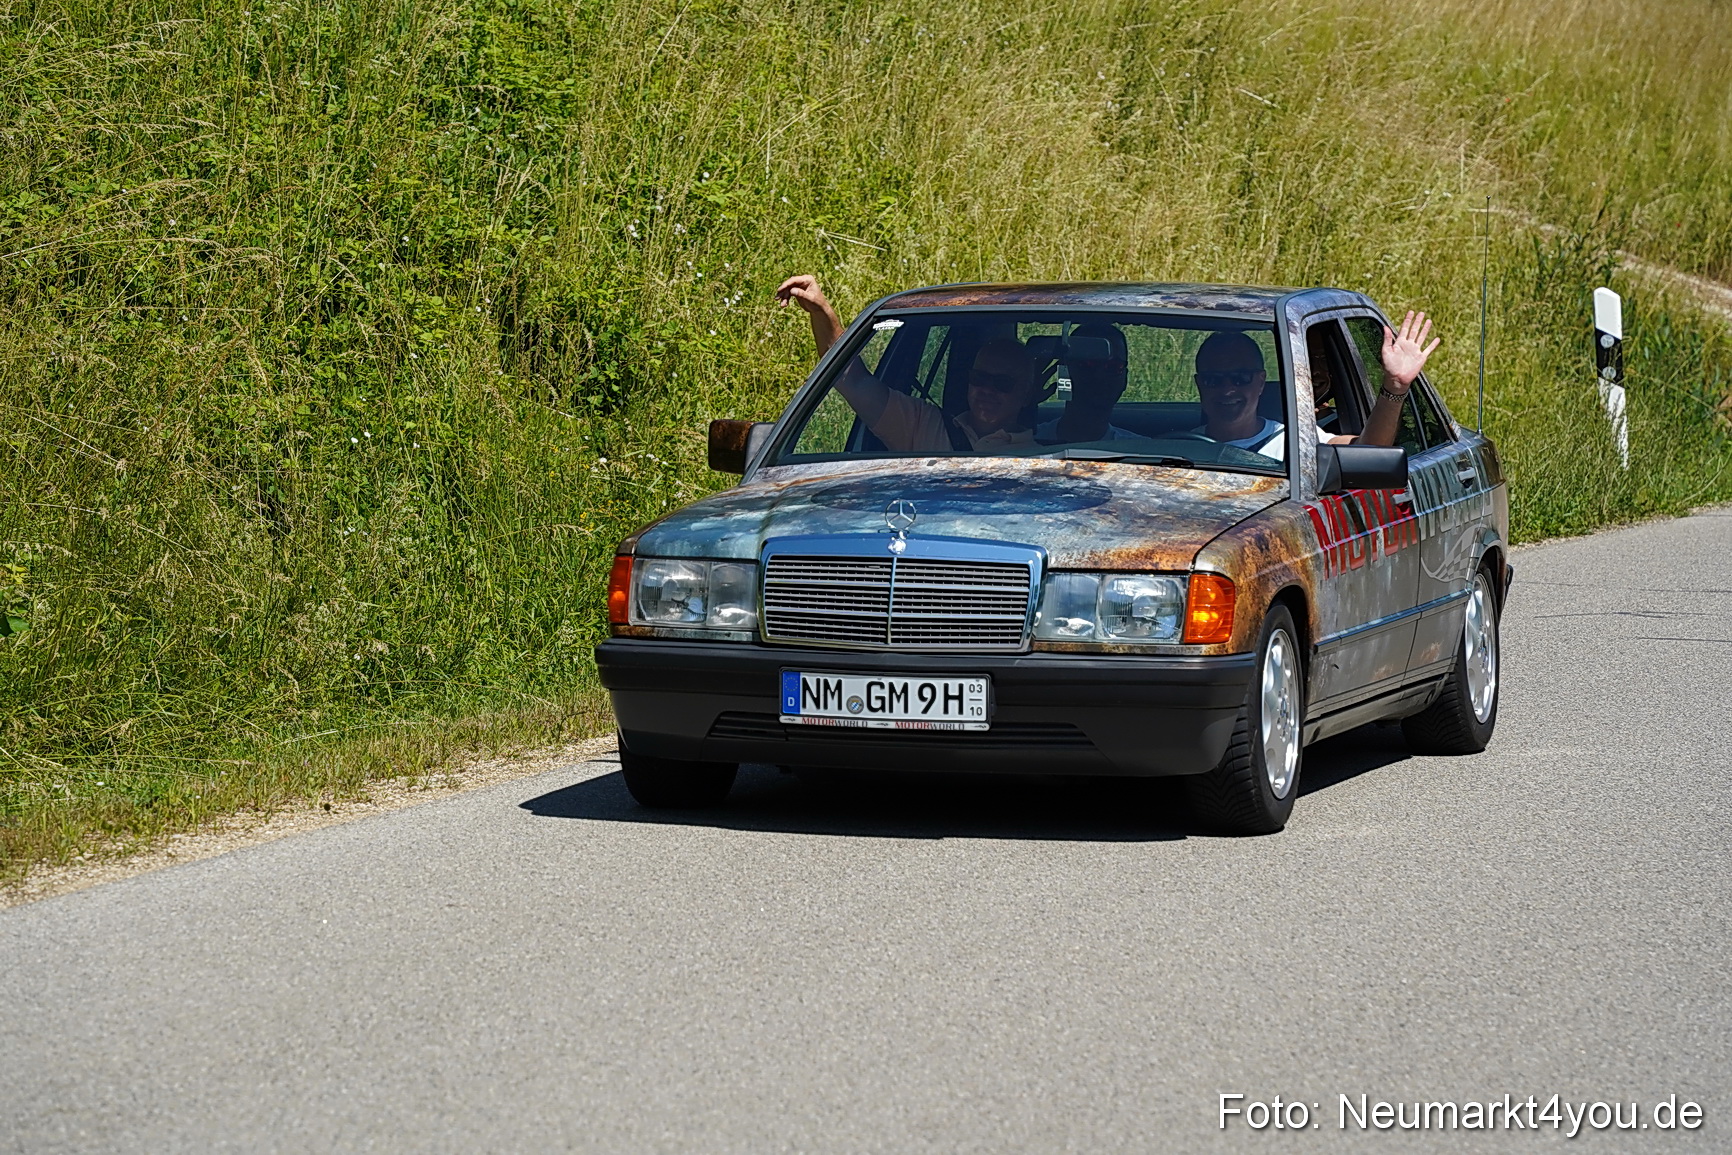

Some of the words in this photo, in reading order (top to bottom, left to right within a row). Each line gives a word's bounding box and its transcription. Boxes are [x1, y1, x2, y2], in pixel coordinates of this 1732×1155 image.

[968, 683, 983, 694] 03
[802, 677, 842, 711] NM
[866, 680, 909, 714] GM
[917, 682, 964, 715] 9H
[787, 697, 795, 707] D
[969, 706, 983, 717] 10
[801, 717, 868, 728] MOTORWORLD
[894, 721, 965, 731] MOTORWORLD
